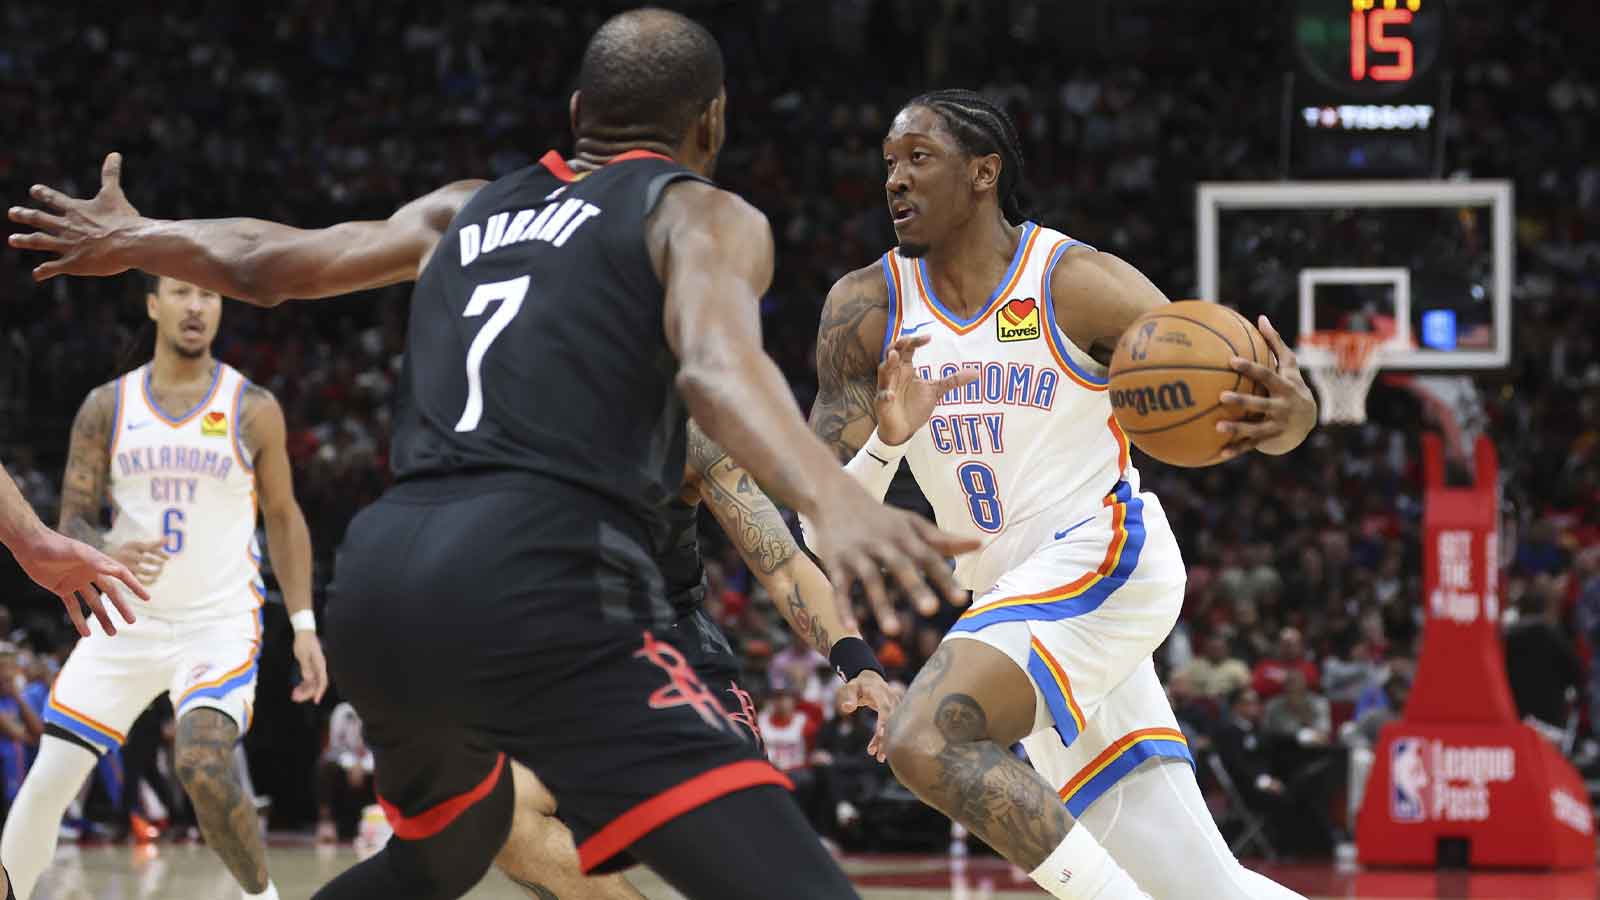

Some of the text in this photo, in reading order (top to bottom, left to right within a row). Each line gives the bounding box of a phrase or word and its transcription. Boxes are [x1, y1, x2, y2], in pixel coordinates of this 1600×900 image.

[1350, 9, 1414, 81] 15
[459, 198, 601, 266] DURANT
[454, 275, 531, 432] 7
[929, 413, 1004, 454] CITY
[117, 446, 232, 480] OKLAHOMA
[151, 478, 198, 503] CITY
[957, 461, 1003, 534] 8
[1432, 738, 1515, 784] League
[1432, 780, 1489, 820] Pass
